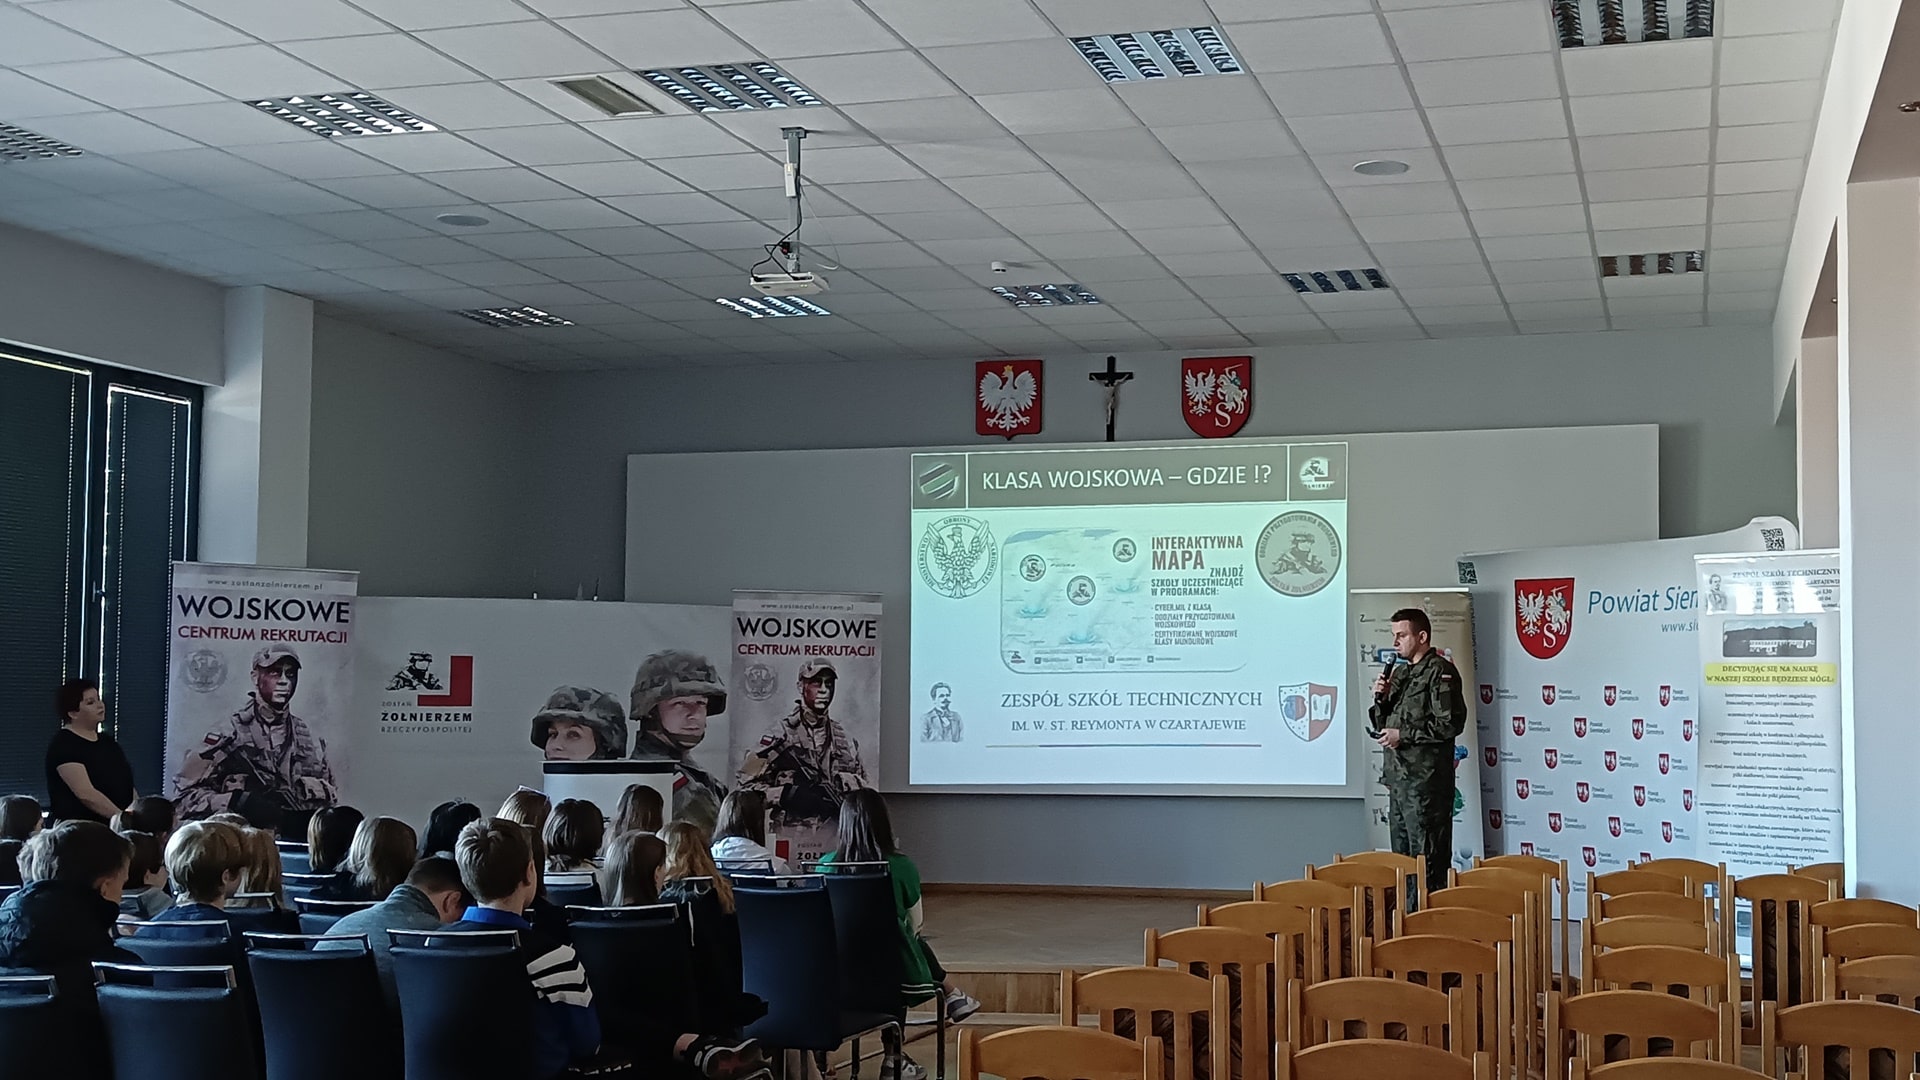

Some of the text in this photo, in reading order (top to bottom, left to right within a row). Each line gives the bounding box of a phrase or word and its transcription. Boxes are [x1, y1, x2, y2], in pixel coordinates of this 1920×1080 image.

[983, 471, 1042, 490] KLASA
[1049, 468, 1164, 488] WOJSKOWA
[1187, 466, 1246, 485] GDZIE
[1254, 465, 1271, 483] !?
[1152, 536, 1244, 550] INTERAKTYWNA
[1152, 550, 1205, 570] MAPA
[1151, 578, 1244, 588] SZKOŁY UCZESTNICZĄCE
[1151, 587, 1220, 596] W PROGRAMACH:
[178, 594, 350, 623] WOJSKOWE
[1588, 590, 1659, 614] Powiat
[178, 626, 348, 644] CENTRUM REKRUTACJI
[737, 617, 876, 639] WOJSKOWE
[738, 644, 875, 656] CENTRUM REKRUTACJI
[1772, 676, 1808, 684] BĘDZIESZ
[1001, 690, 1262, 708] ZESPÓŁ SZKÓŁ TECHNICZNYCH
[381, 710, 472, 721] ŻOŁNIERZEM
[1034, 720, 1048, 731] W.
[1050, 721, 1068, 731] ST.
[1071, 720, 1142, 731] REYMONTA
[1144, 720, 1157, 730] W
[1159, 720, 1246, 730] CZARTAJEWIE
